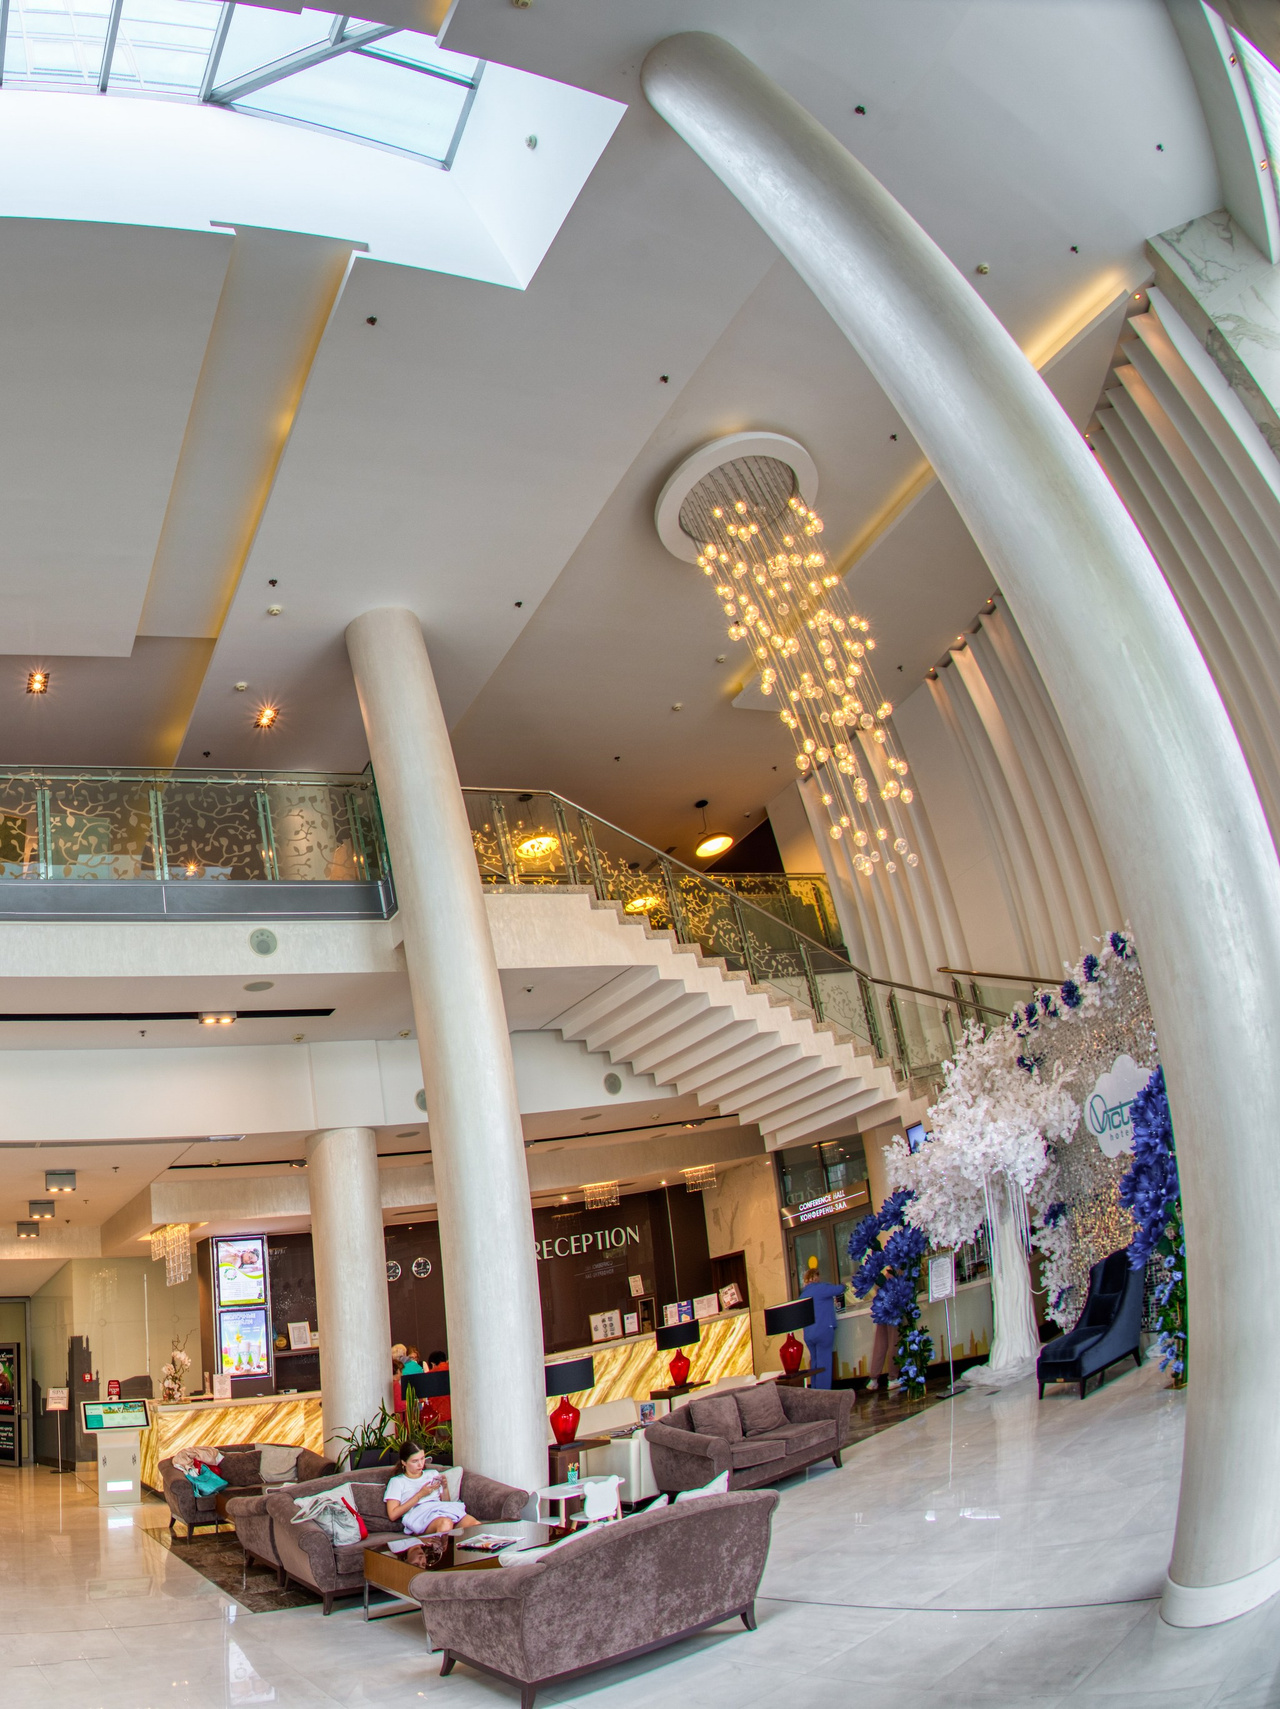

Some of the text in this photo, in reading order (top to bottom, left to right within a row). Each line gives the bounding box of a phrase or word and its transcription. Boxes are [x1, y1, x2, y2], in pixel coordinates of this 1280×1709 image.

[798, 1195, 832, 1211] CONFERENCE
[833, 1190, 846, 1200] HALL
[800, 1201, 847, 1222] КОНФЕРЕНЦ-ЗАЛ
